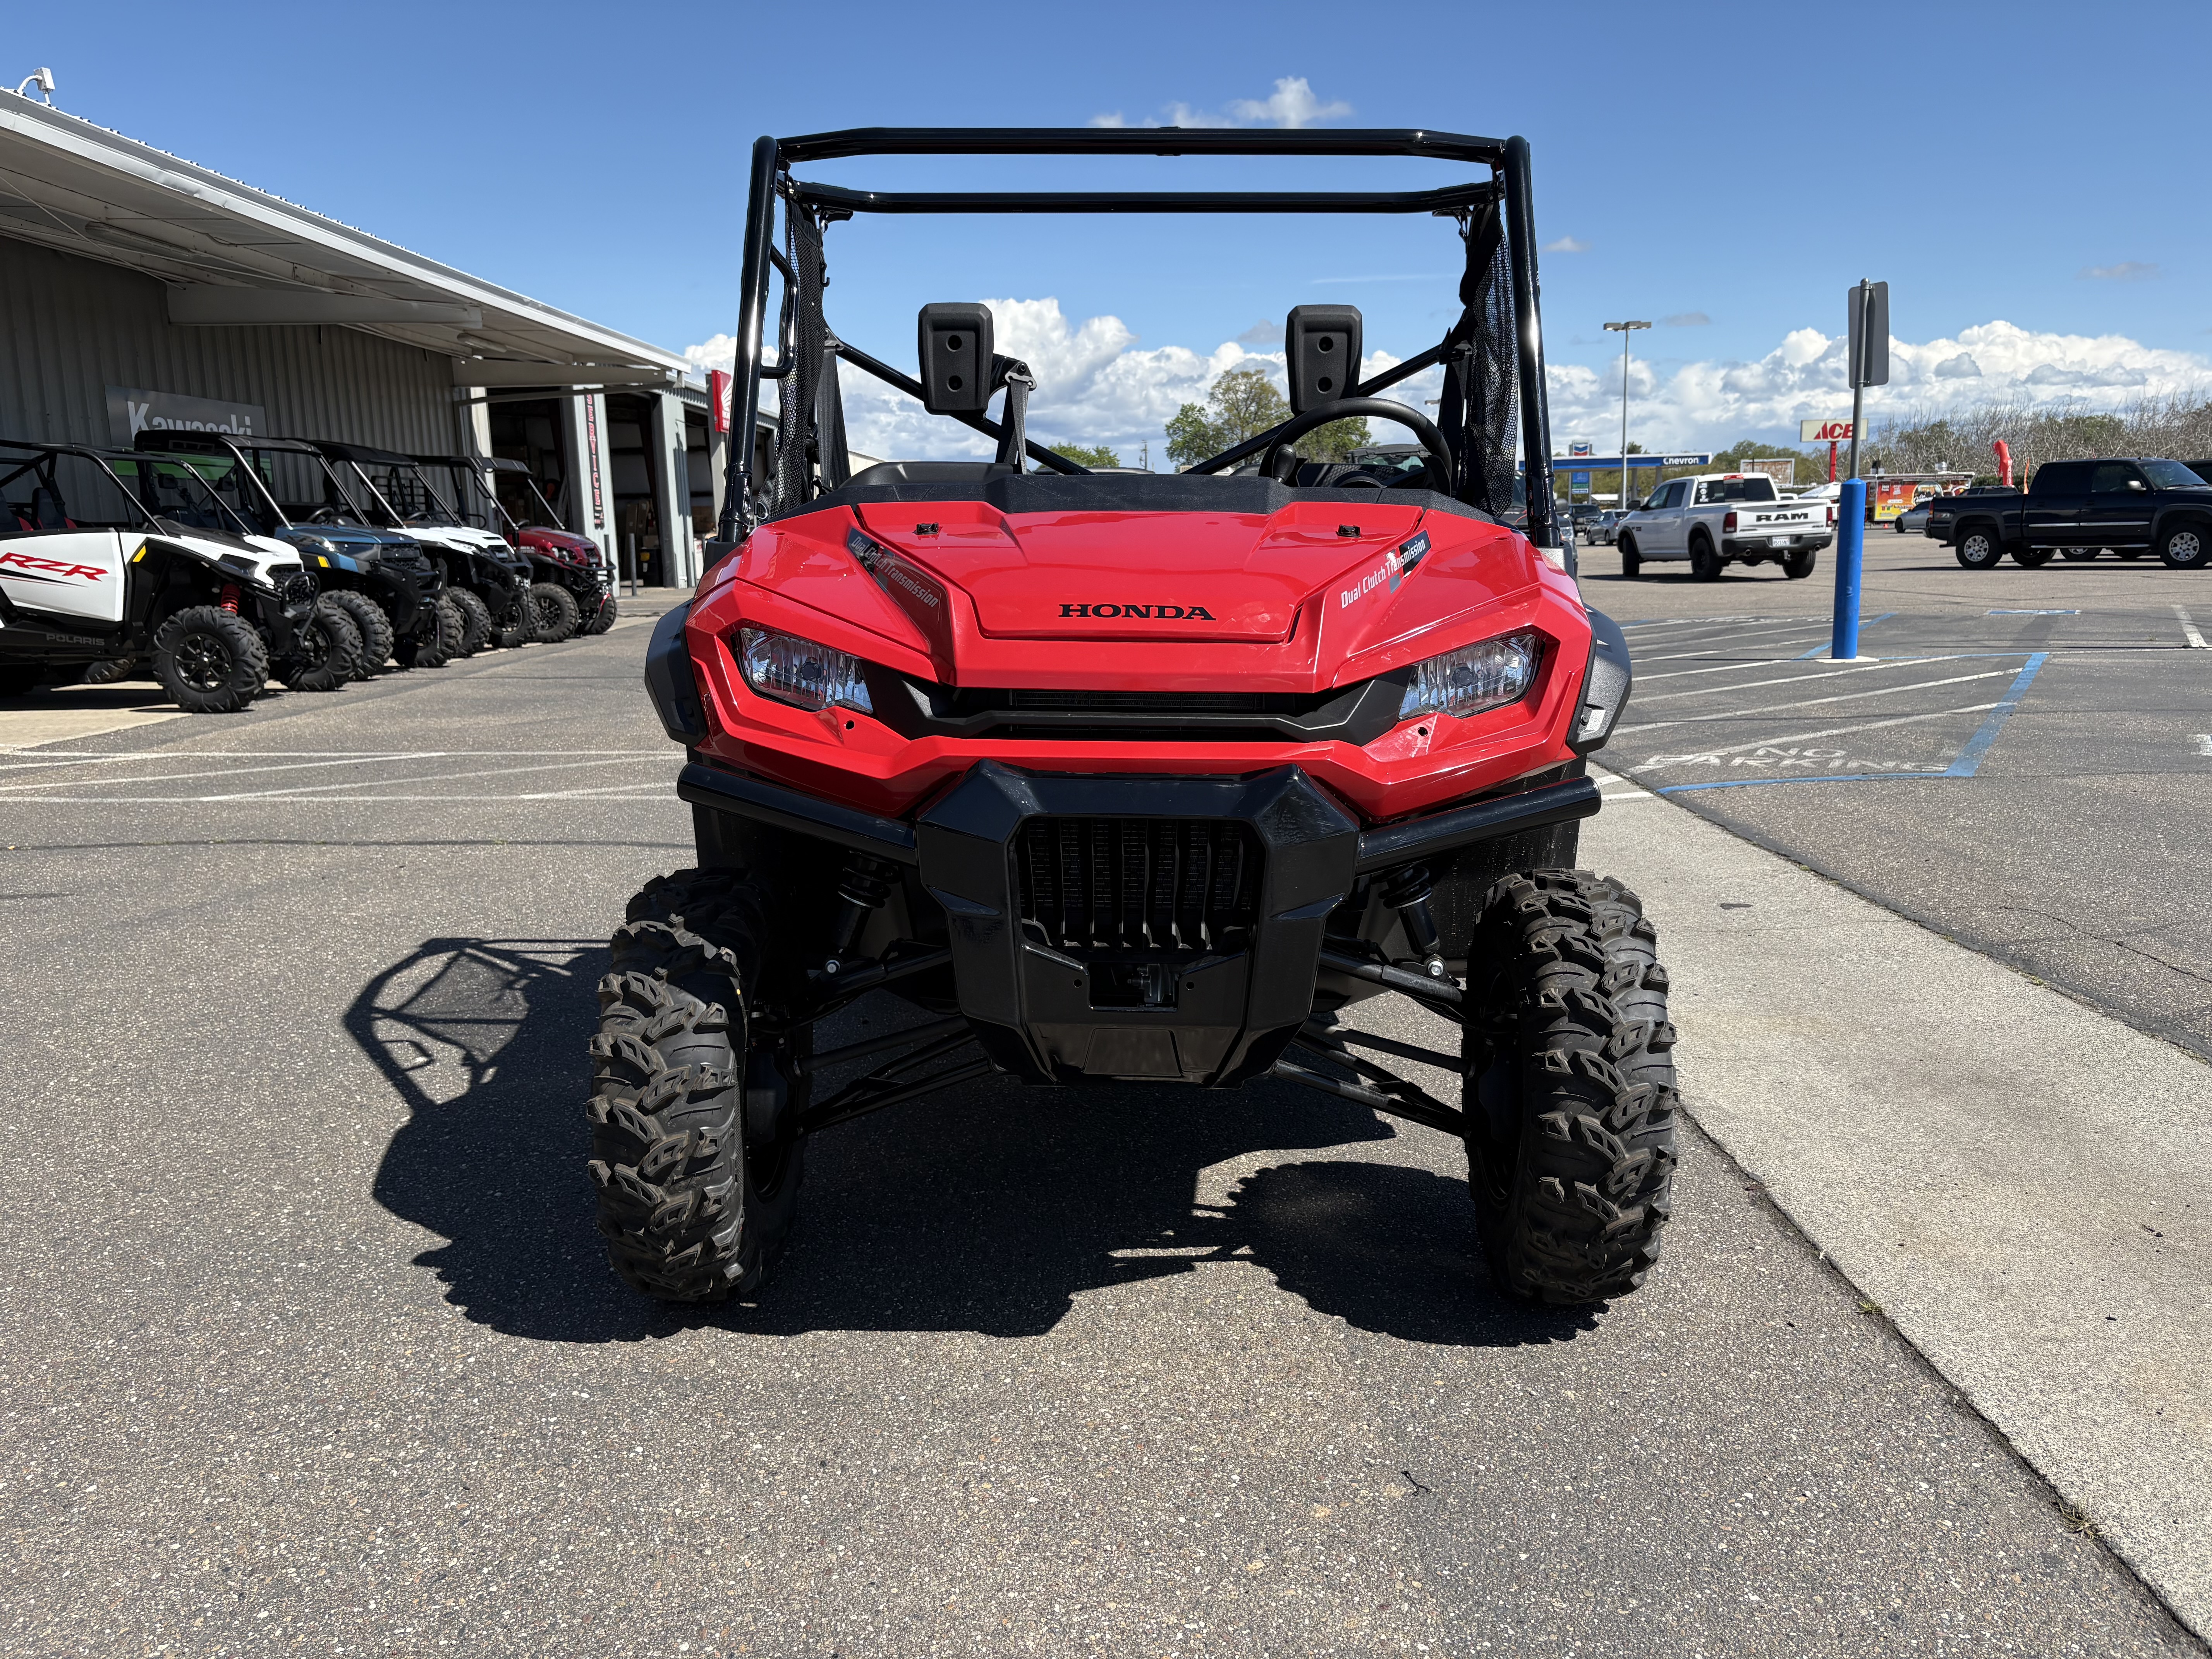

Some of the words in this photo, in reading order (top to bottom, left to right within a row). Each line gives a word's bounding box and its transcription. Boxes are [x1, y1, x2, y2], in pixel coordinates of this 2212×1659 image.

[1814, 421, 1853, 440] ACE
[1663, 457, 1699, 465] Chevron
[1756, 513, 1808, 522] RAM
[0, 552, 109, 582] RZR
[851, 536, 870, 555] Dual
[864, 547, 888, 570] Clutch
[884, 562, 939, 608] Transmission
[1341, 582, 1361, 609] Dual
[1363, 566, 1386, 594] Clutch
[1385, 539, 1426, 576] Transmission
[1058, 604, 1217, 620] HONDA
[46, 634, 105, 646] POLARIS
[1754, 747, 1847, 757] NO
